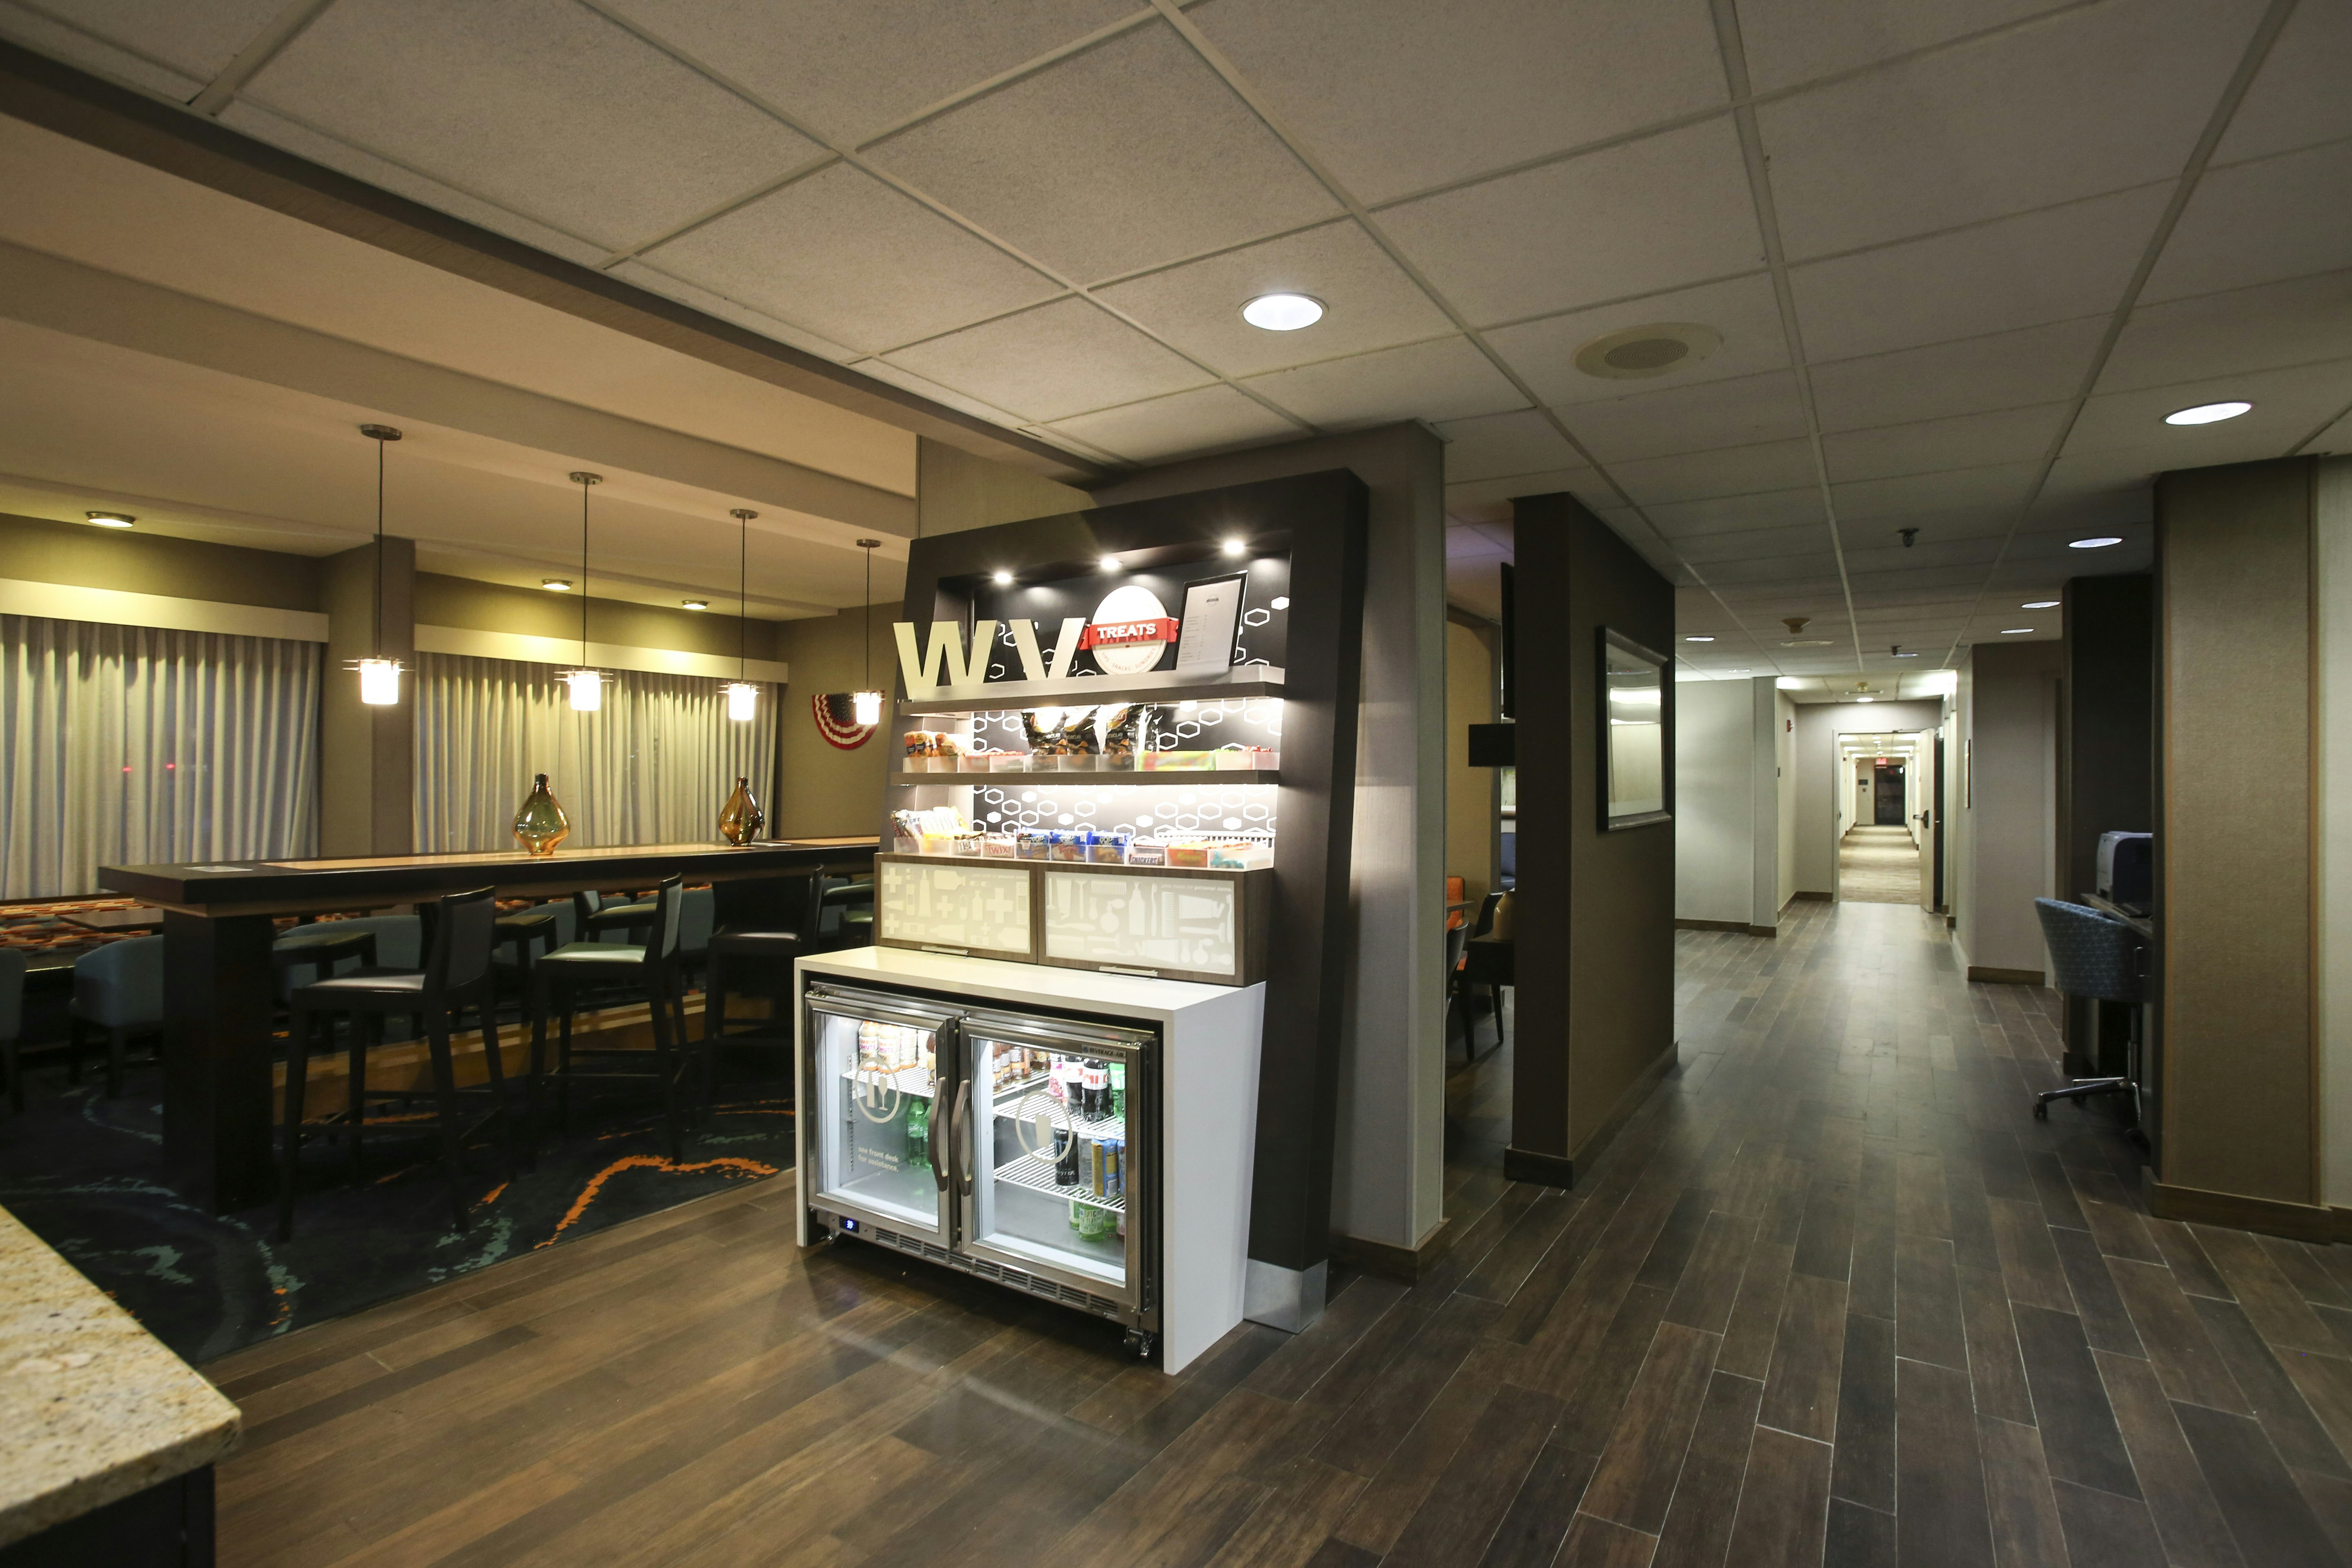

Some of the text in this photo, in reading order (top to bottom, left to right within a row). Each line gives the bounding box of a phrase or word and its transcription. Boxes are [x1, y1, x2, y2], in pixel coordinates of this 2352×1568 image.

[1097, 623, 1156, 639] TREATS
[1101, 647, 1156, 671] SIPS SNACKS SUNDRIES
[858, 1154, 867, 1163] for
[869, 1148, 884, 1159] front
[885, 1154, 898, 1163] desk
